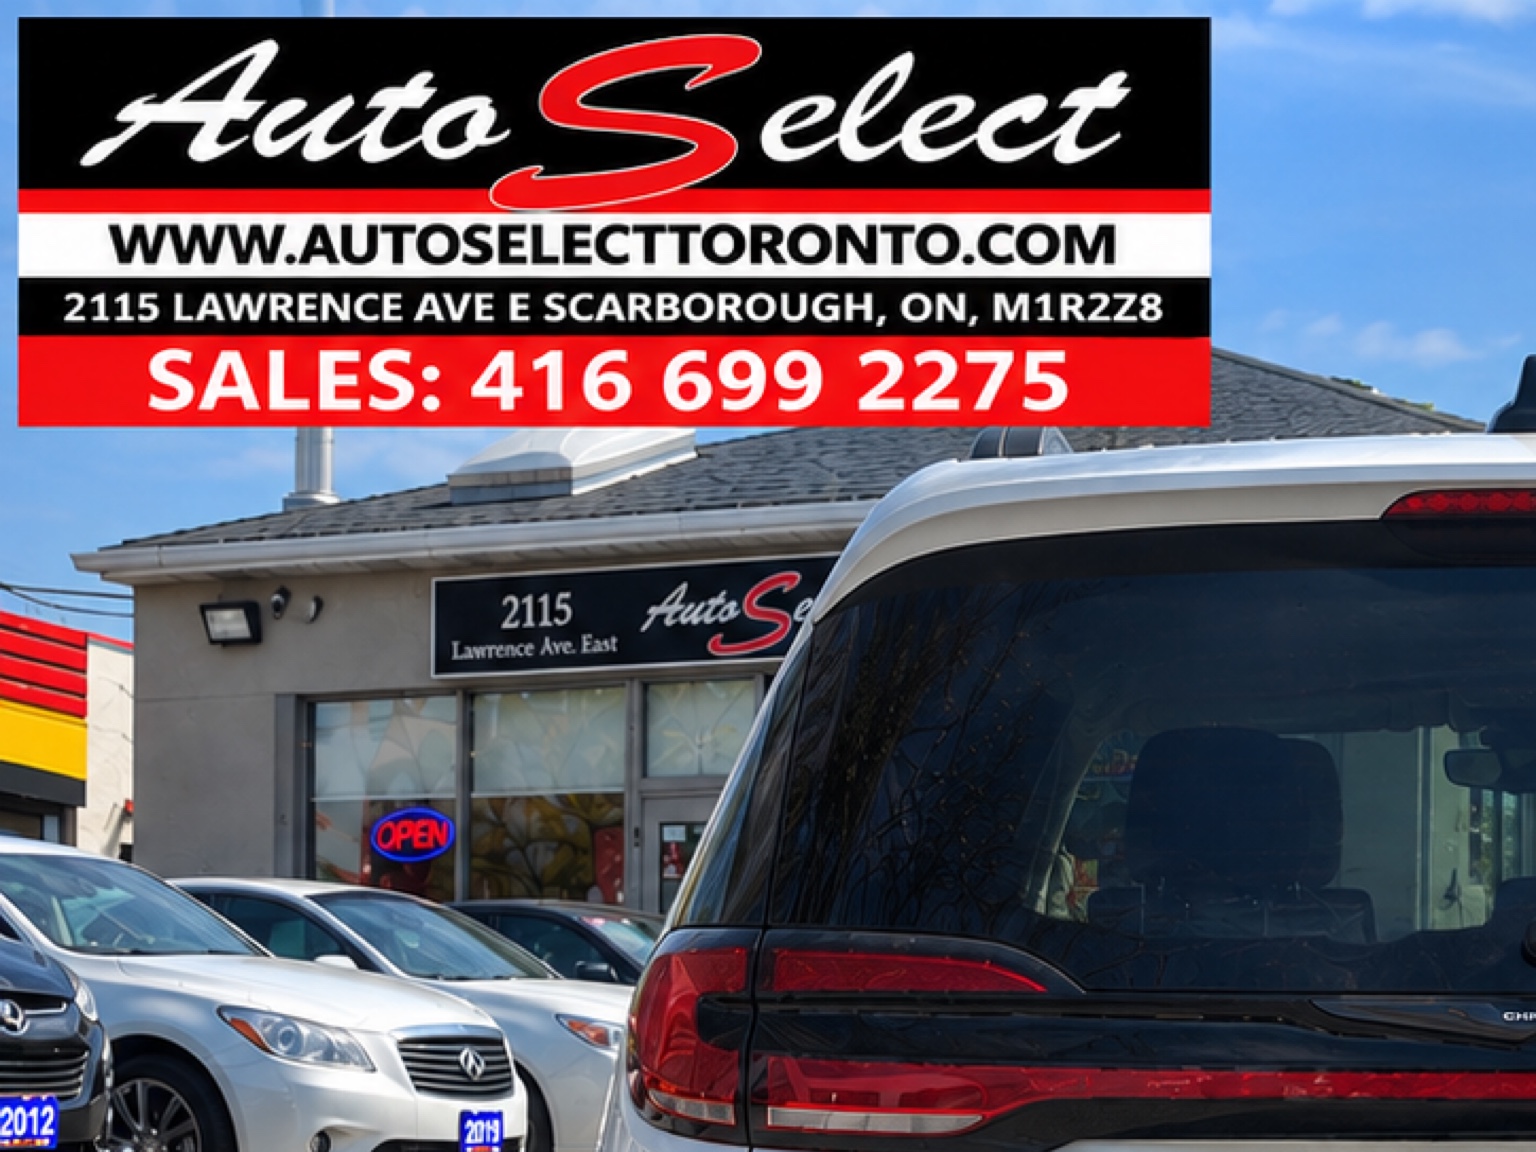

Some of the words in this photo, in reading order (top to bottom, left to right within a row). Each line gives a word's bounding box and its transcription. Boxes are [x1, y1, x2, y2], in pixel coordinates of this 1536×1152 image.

[501, 591, 573, 630] 2115
[640, 581, 740, 633] Auto
[451, 638, 535, 661] Lawrence
[540, 634, 578, 657] Ave.
[581, 632, 619, 655] East
[377, 818, 449, 851] OPEN
[0, 1104, 55, 1136] 2012
